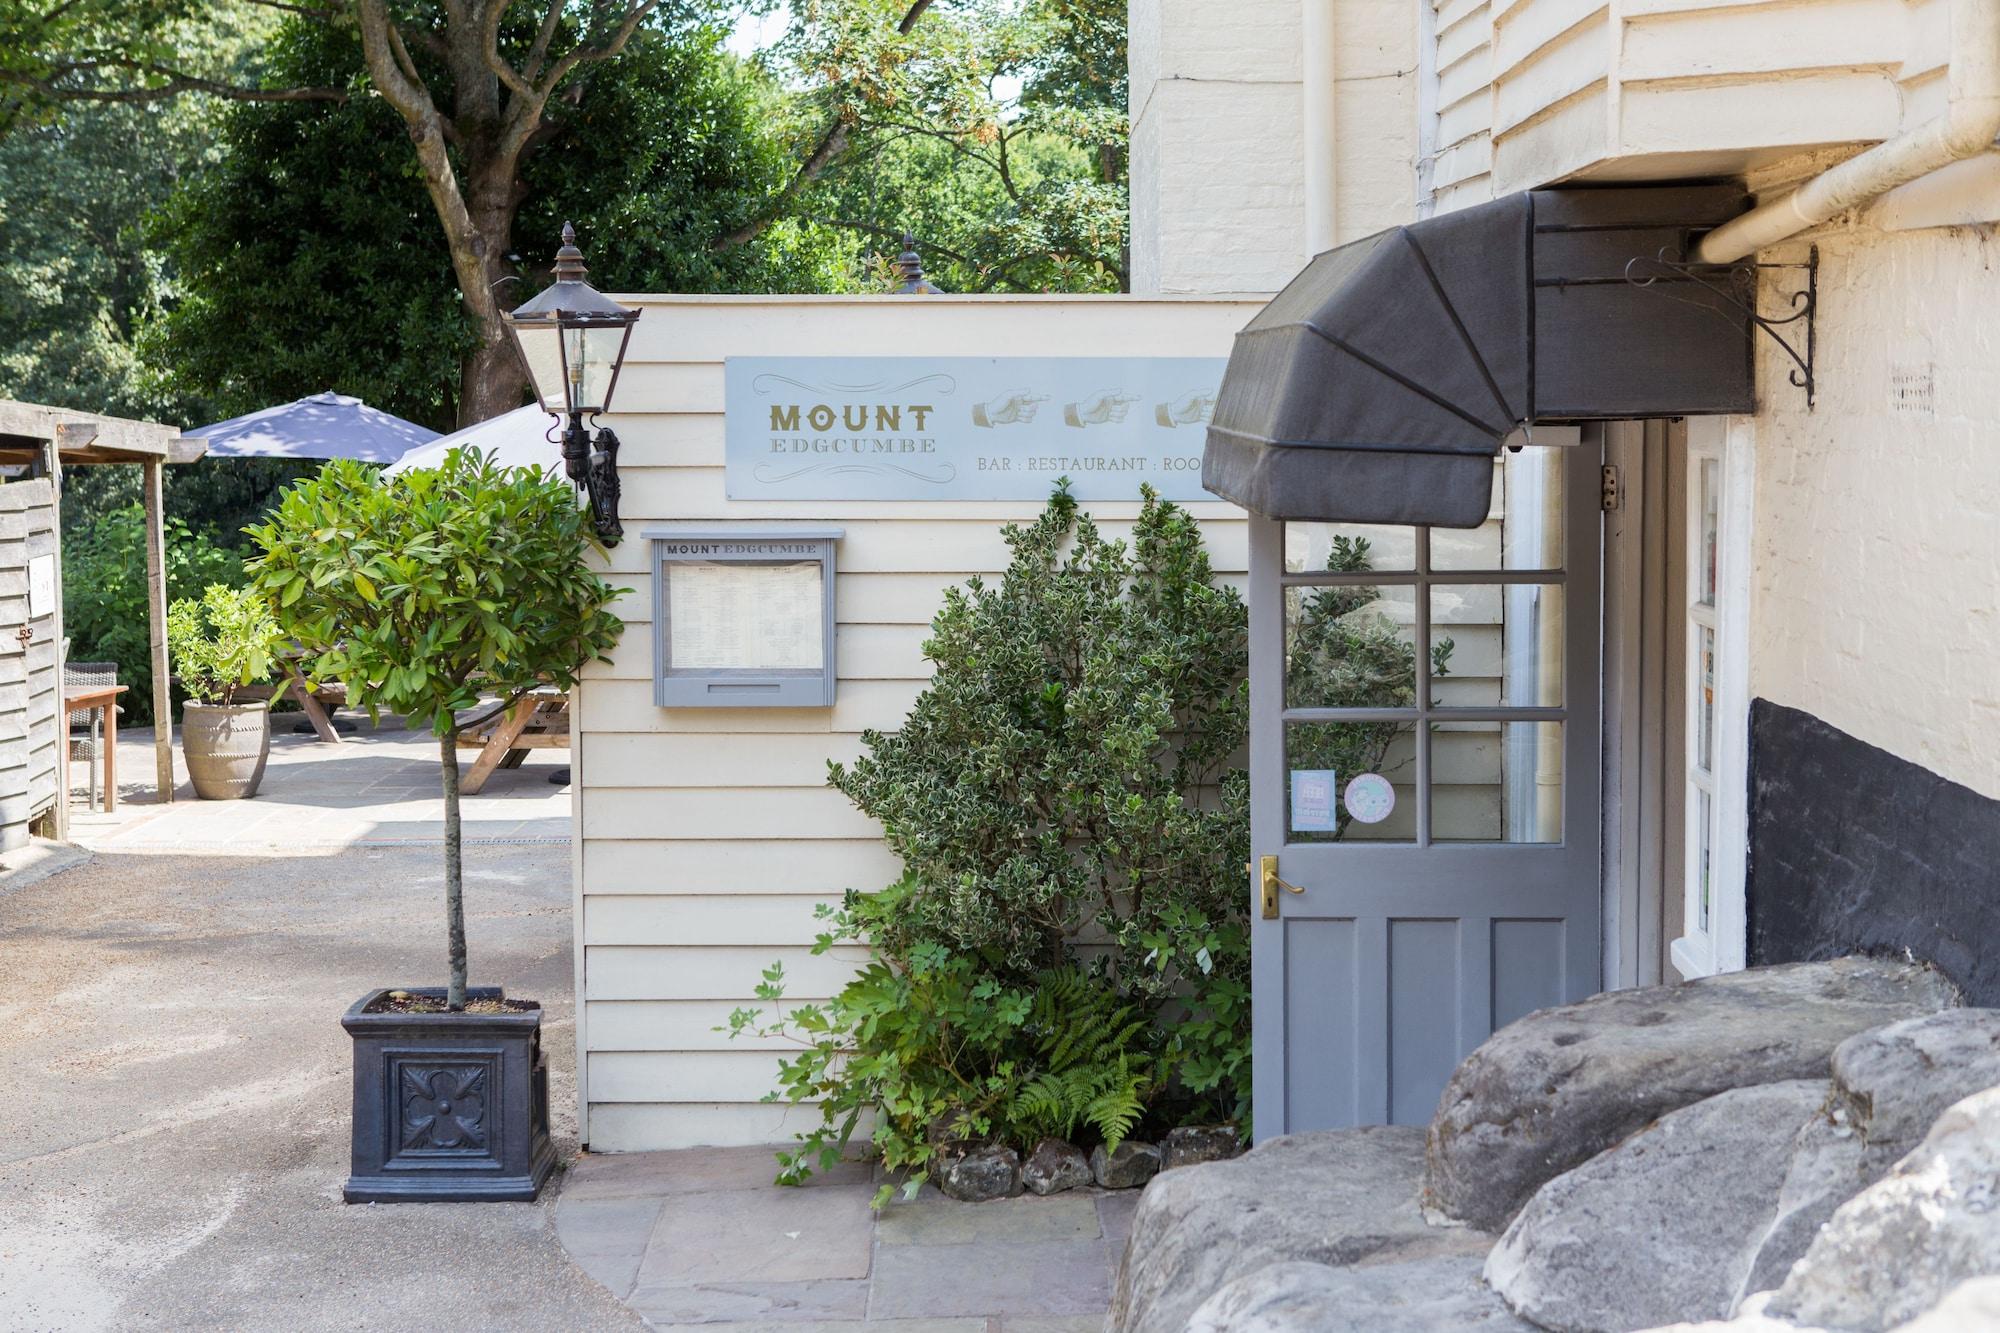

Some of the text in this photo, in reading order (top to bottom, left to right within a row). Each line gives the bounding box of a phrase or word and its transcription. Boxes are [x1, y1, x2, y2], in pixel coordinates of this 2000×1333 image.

[769, 404, 934, 432] MOUNT
[770, 438, 936, 453] EDGCUMBE
[978, 457, 1011, 471] BAR
[1028, 457, 1147, 471] RESTAURANT
[667, 544, 816, 554] MOUNT EDGCUMBE
